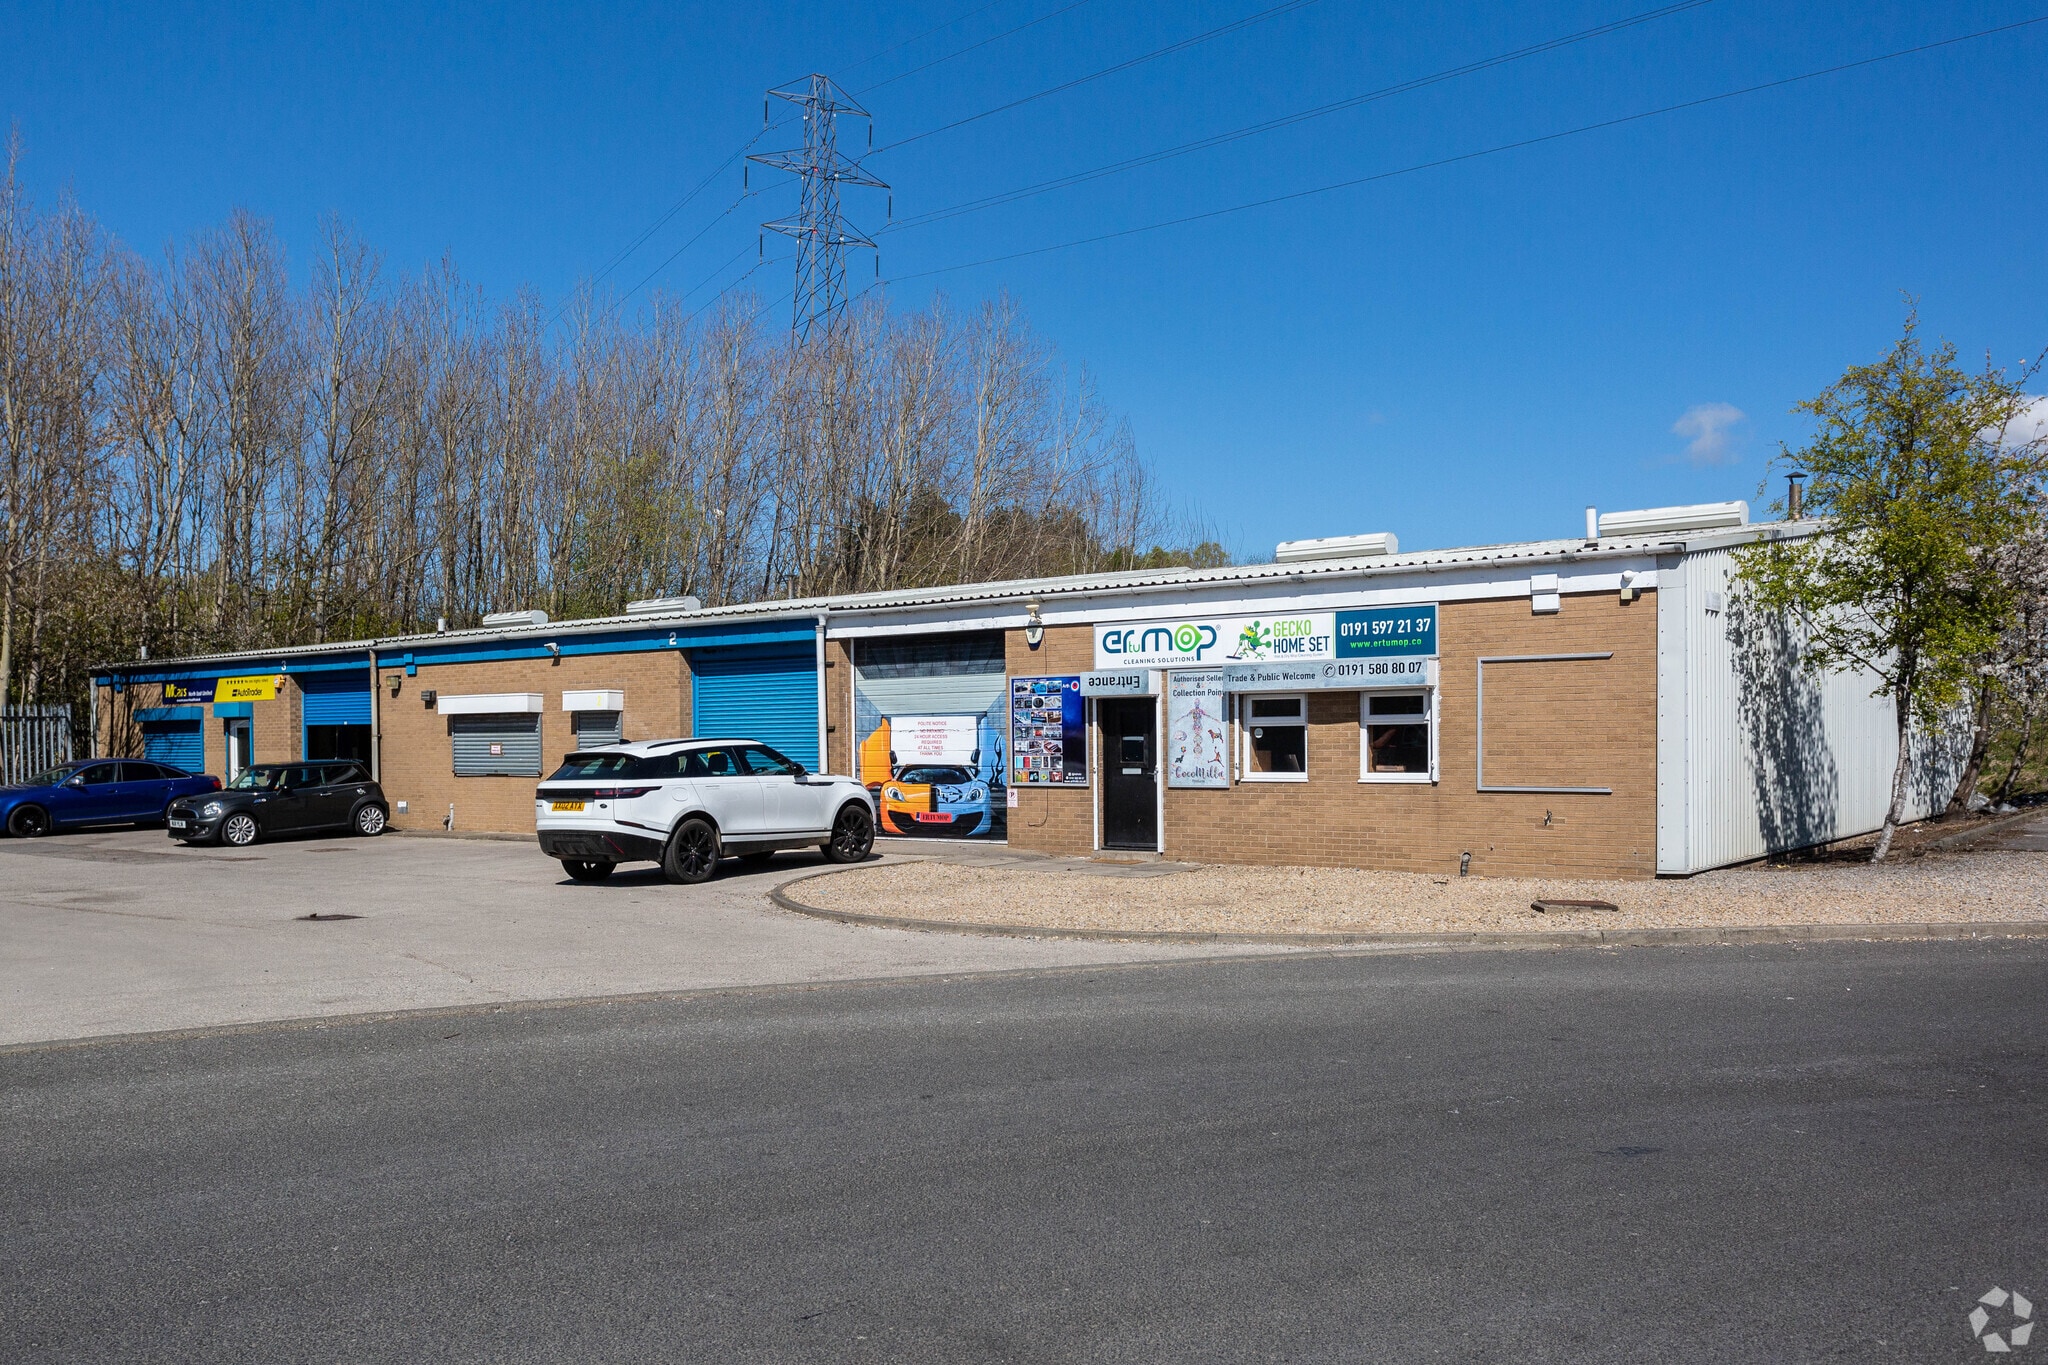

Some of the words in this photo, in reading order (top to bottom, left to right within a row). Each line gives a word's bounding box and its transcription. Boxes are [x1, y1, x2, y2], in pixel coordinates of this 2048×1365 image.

[1273, 619, 1312, 638] GECKO
[1340, 621, 1368, 637] 0191
[1372, 620, 1395, 635] 597
[1397, 619, 1412, 634] 21
[1415, 618, 1431, 633] 37
[668, 632, 677, 645] 2
[1273, 637, 1306, 654] HOME
[1308, 635, 1330, 651] SET
[1349, 637, 1422, 649] www.ertumop.co
[281, 660, 287, 671] 3
[1123, 657, 1156, 665] CLEANING
[1157, 656, 1195, 664] SOLUTIONS
[1338, 664, 1364, 676] 0191
[1368, 663, 1388, 675] 580
[1391, 662, 1405, 674] 80
[1408, 661, 1422, 673] 07
[1088, 675, 1140, 689] Entrance
[1173, 675, 1205, 683] Authorised
[1228, 674, 1248, 683] Trade
[1249, 674, 1256, 682] &
[1257, 673, 1280, 682] Public
[1282, 671, 1316, 681] Welcome
[1207, 688, 1224, 697] Poin
